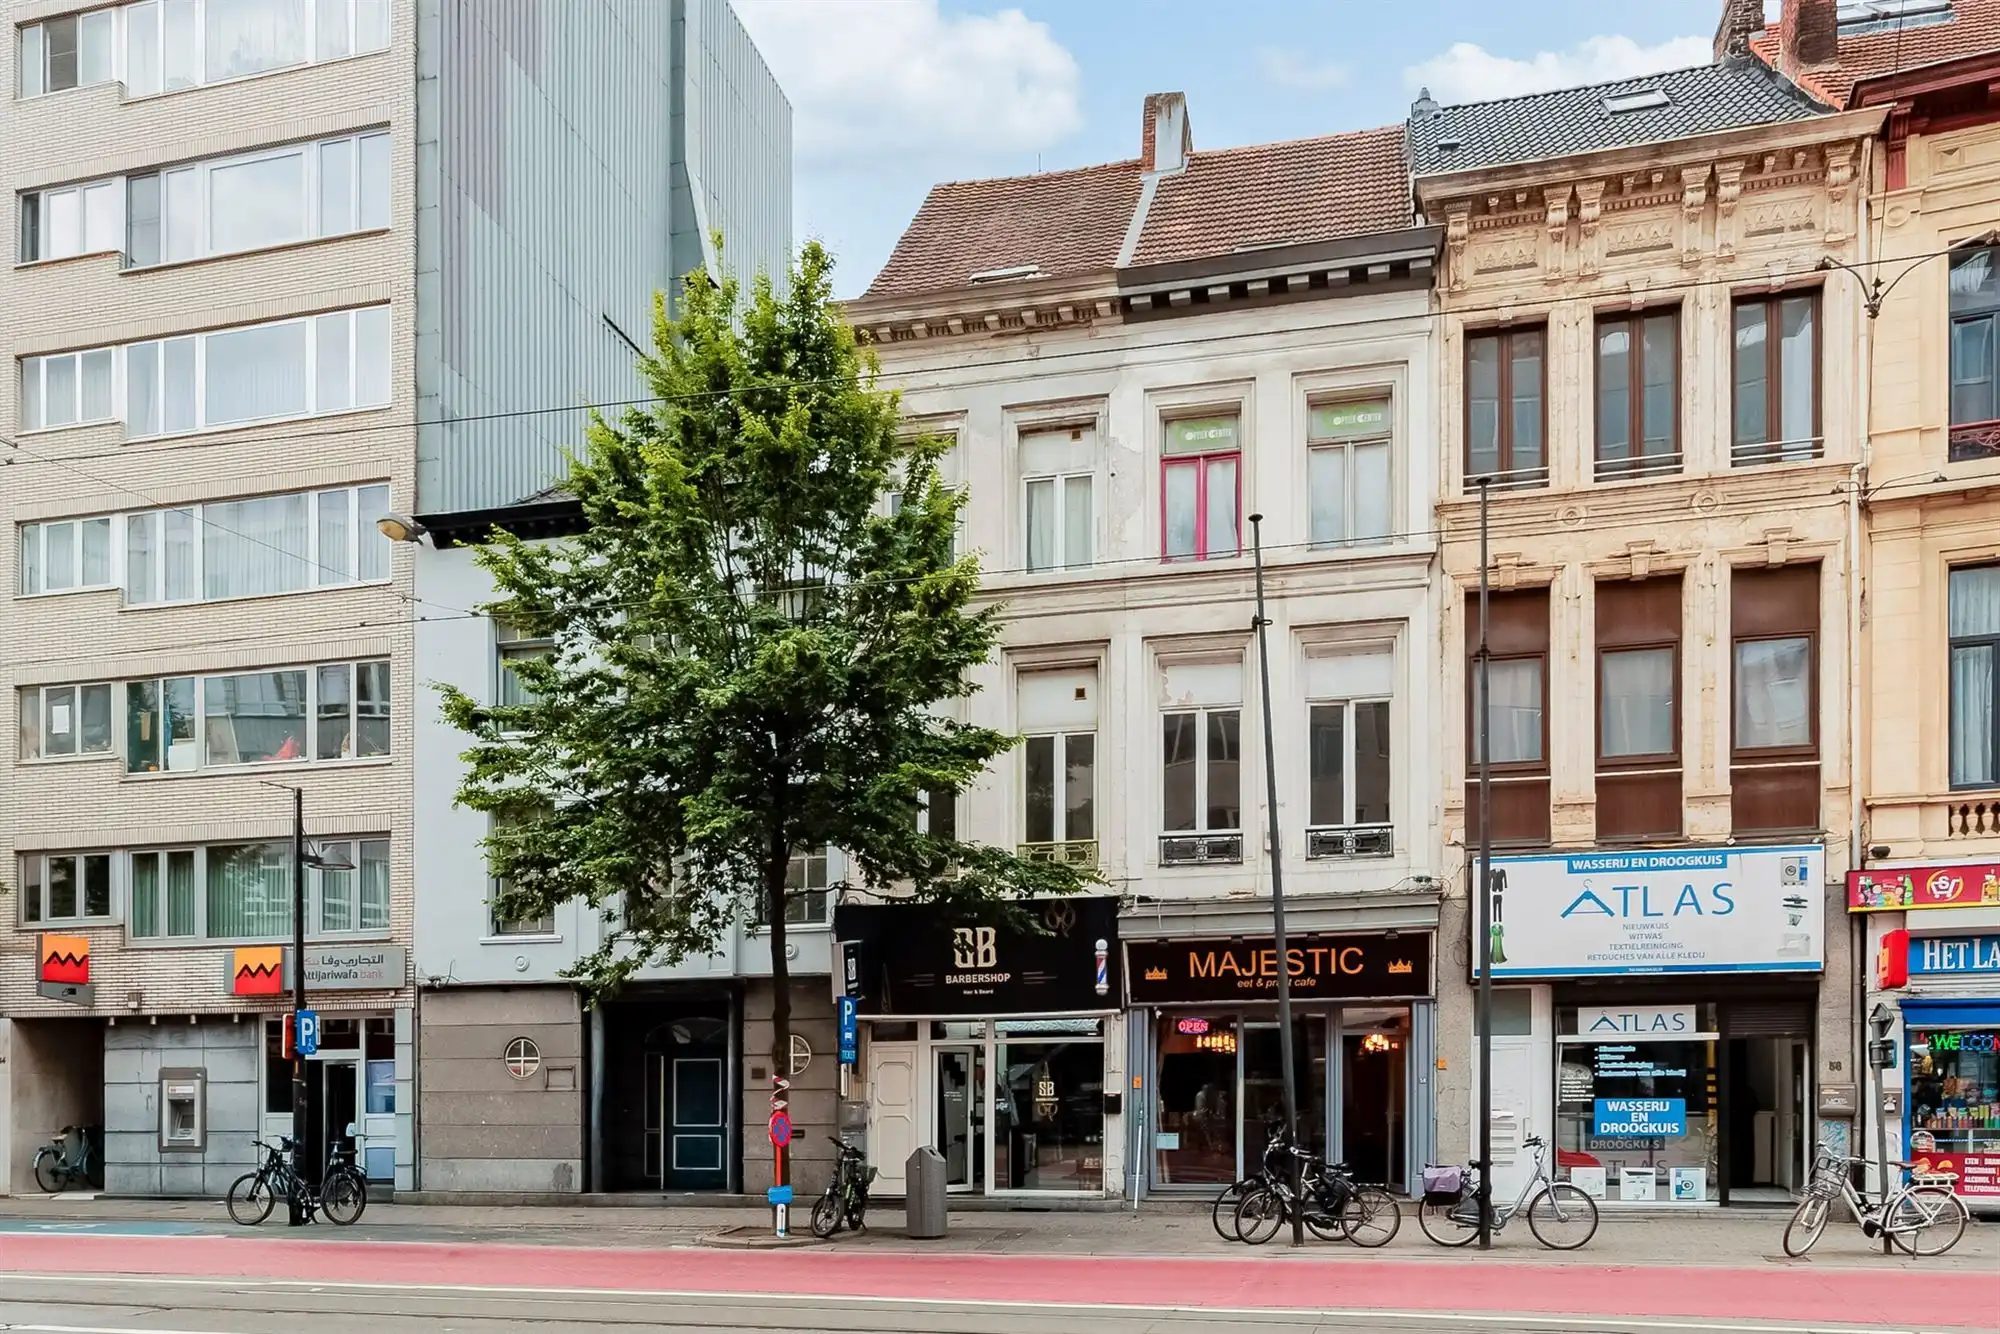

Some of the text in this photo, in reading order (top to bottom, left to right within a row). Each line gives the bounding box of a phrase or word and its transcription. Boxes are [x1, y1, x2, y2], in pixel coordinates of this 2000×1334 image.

[1572, 855, 1723, 870] WASSERIJ EN DROOGKUIS
[1560, 881, 1735, 918] ATLAS
[1622, 922, 1669, 931] NIEUWKUIS
[1629, 932, 1663, 940] WITWAS
[1609, 942, 1684, 951] TEXTIELREINIGING
[1587, 953, 1635, 961] RETOUCHES
[1677, 951, 1706, 959] KLEDIJ
[1923, 939, 1969, 970] HET
[1189, 947, 1364, 978] MAJESTIC
[945, 973, 1011, 984] BARBERSHOP
[1256, 978, 1263, 987] &
[1265, 978, 1292, 989] prt
[844, 1001, 853, 1026] P
[1178, 1020, 1208, 1032] OPEN
[1589, 1012, 1685, 1032] ATLAS
[301, 1017, 314, 1047] P
[1039, 1081, 1055, 1096] SB
[1606, 1101, 1670, 1112] WASSERIJ
[1631, 1112, 1648, 1122] EN
[1600, 1123, 1680, 1133] DROOGKUIS
[1590, 1140, 1660, 1149] DROOGKUS
